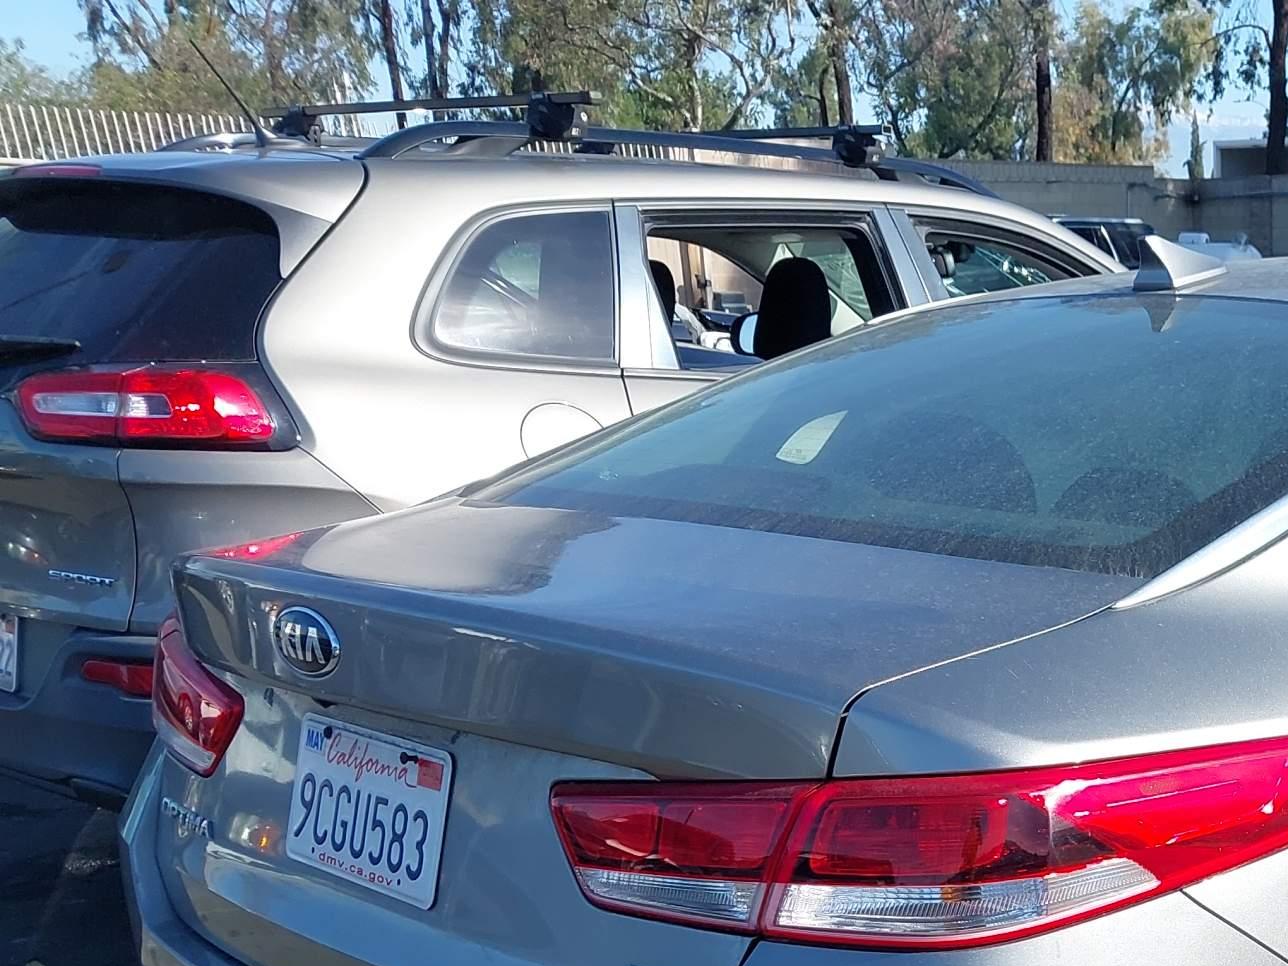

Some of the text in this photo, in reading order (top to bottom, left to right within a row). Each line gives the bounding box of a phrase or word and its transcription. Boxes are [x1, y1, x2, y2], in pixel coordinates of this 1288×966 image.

[48, 569, 115, 587] SPORT
[280, 620, 326, 664] KIA
[305, 729, 325, 750] MAY
[326, 732, 417, 788] California
[293, 772, 429, 881] 9CGU583
[318, 850, 393, 886] dmv.ca.gov
